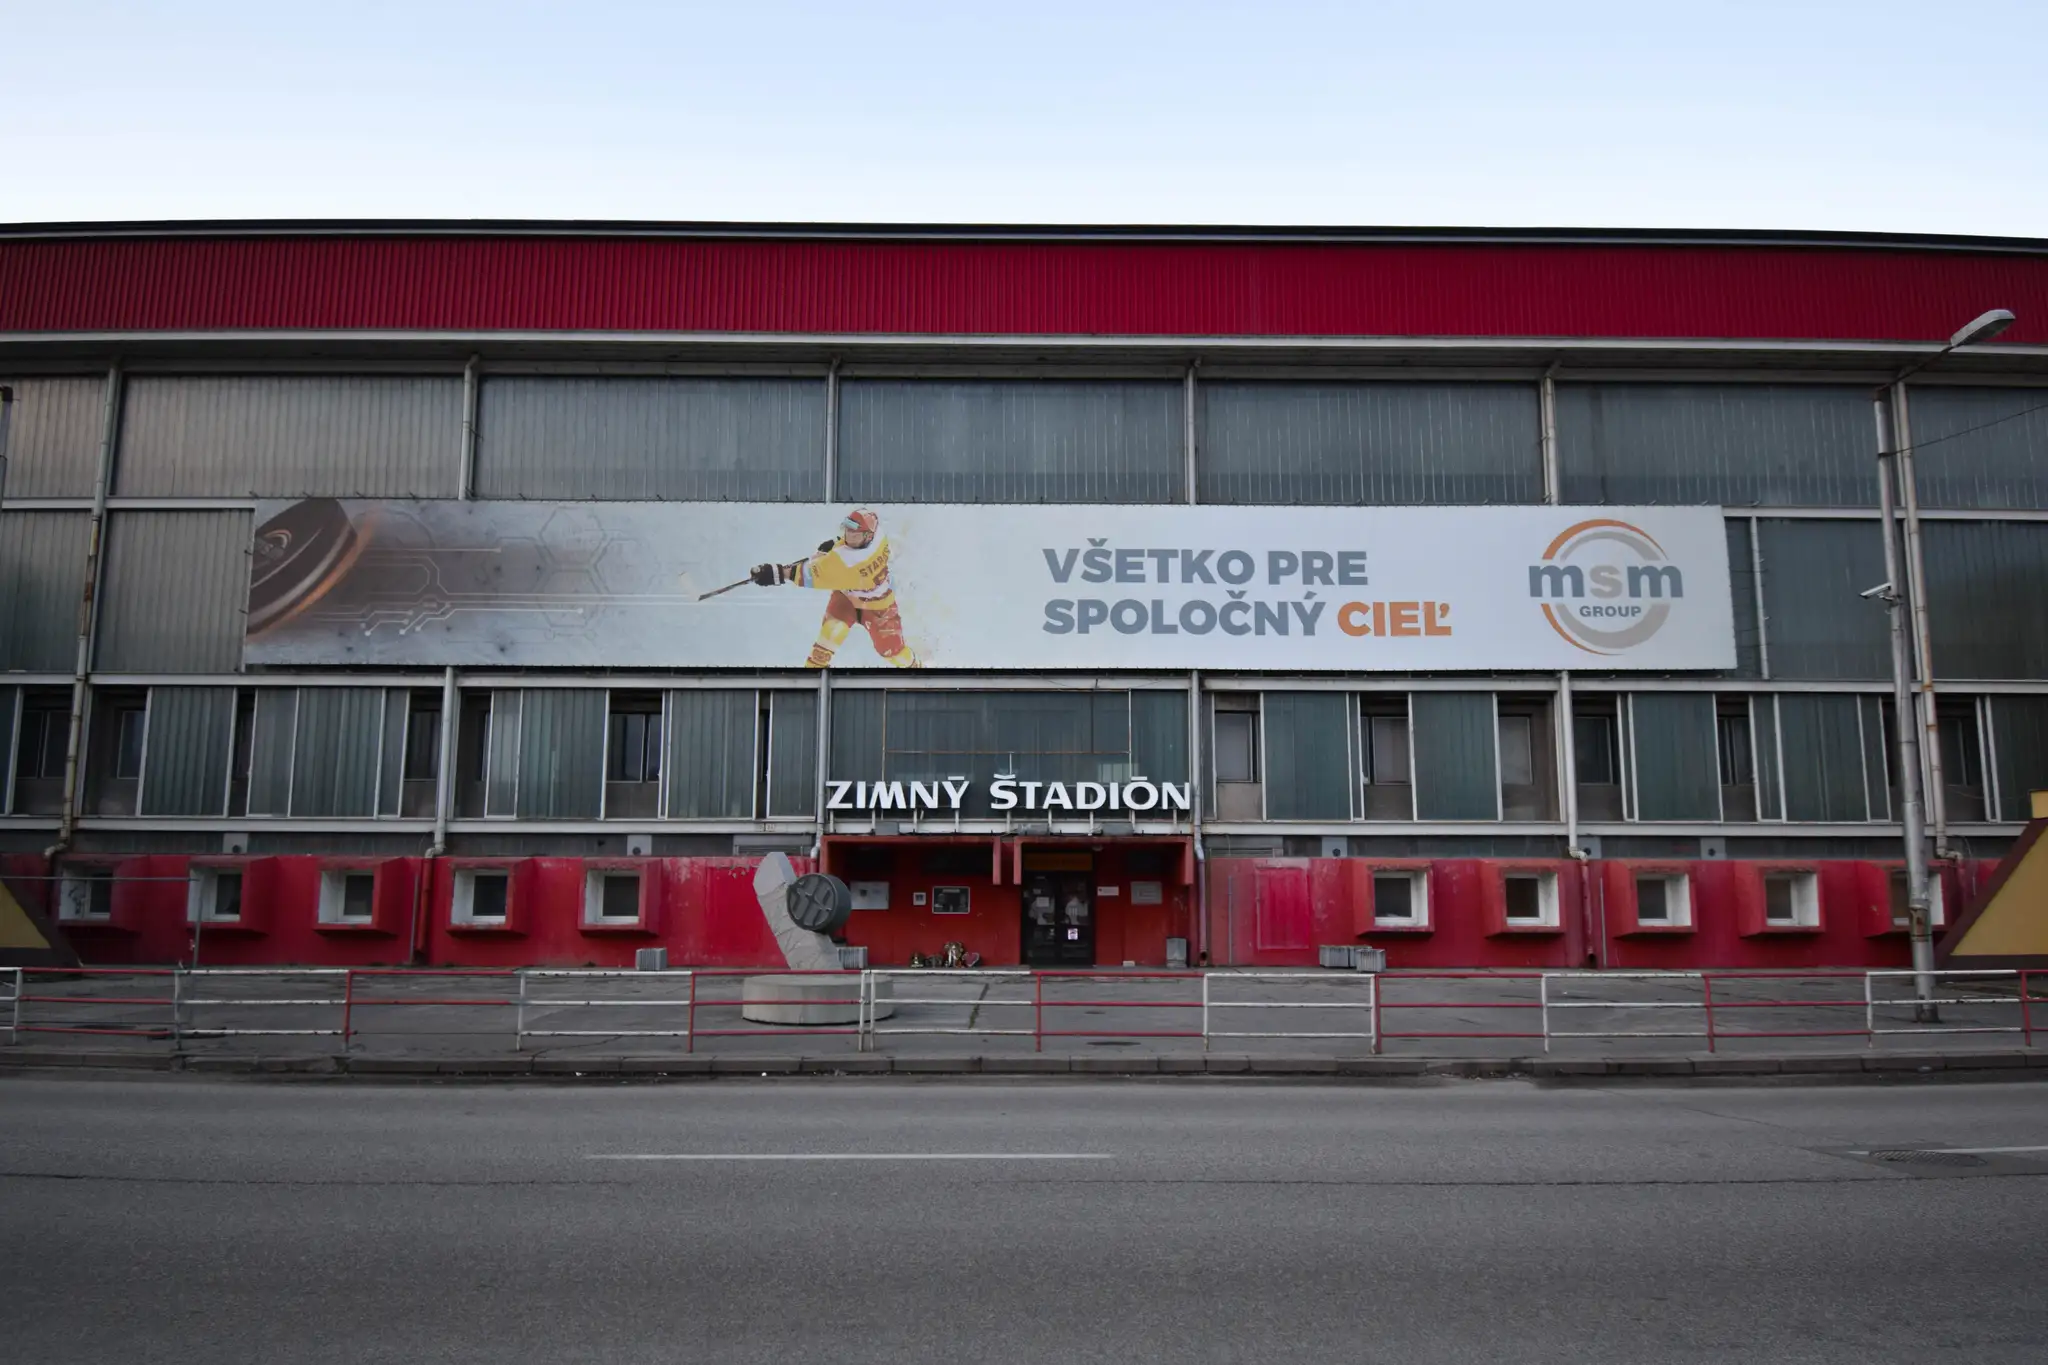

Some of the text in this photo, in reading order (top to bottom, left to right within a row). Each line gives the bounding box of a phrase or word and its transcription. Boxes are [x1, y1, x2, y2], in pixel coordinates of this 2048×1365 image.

[1042, 538, 1368, 586] VŠETKO PRE
[1529, 565, 1684, 599] msm
[1042, 590, 1452, 637] SPOLOČNÝ CIEĽ
[1579, 605, 1642, 618] GROUP
